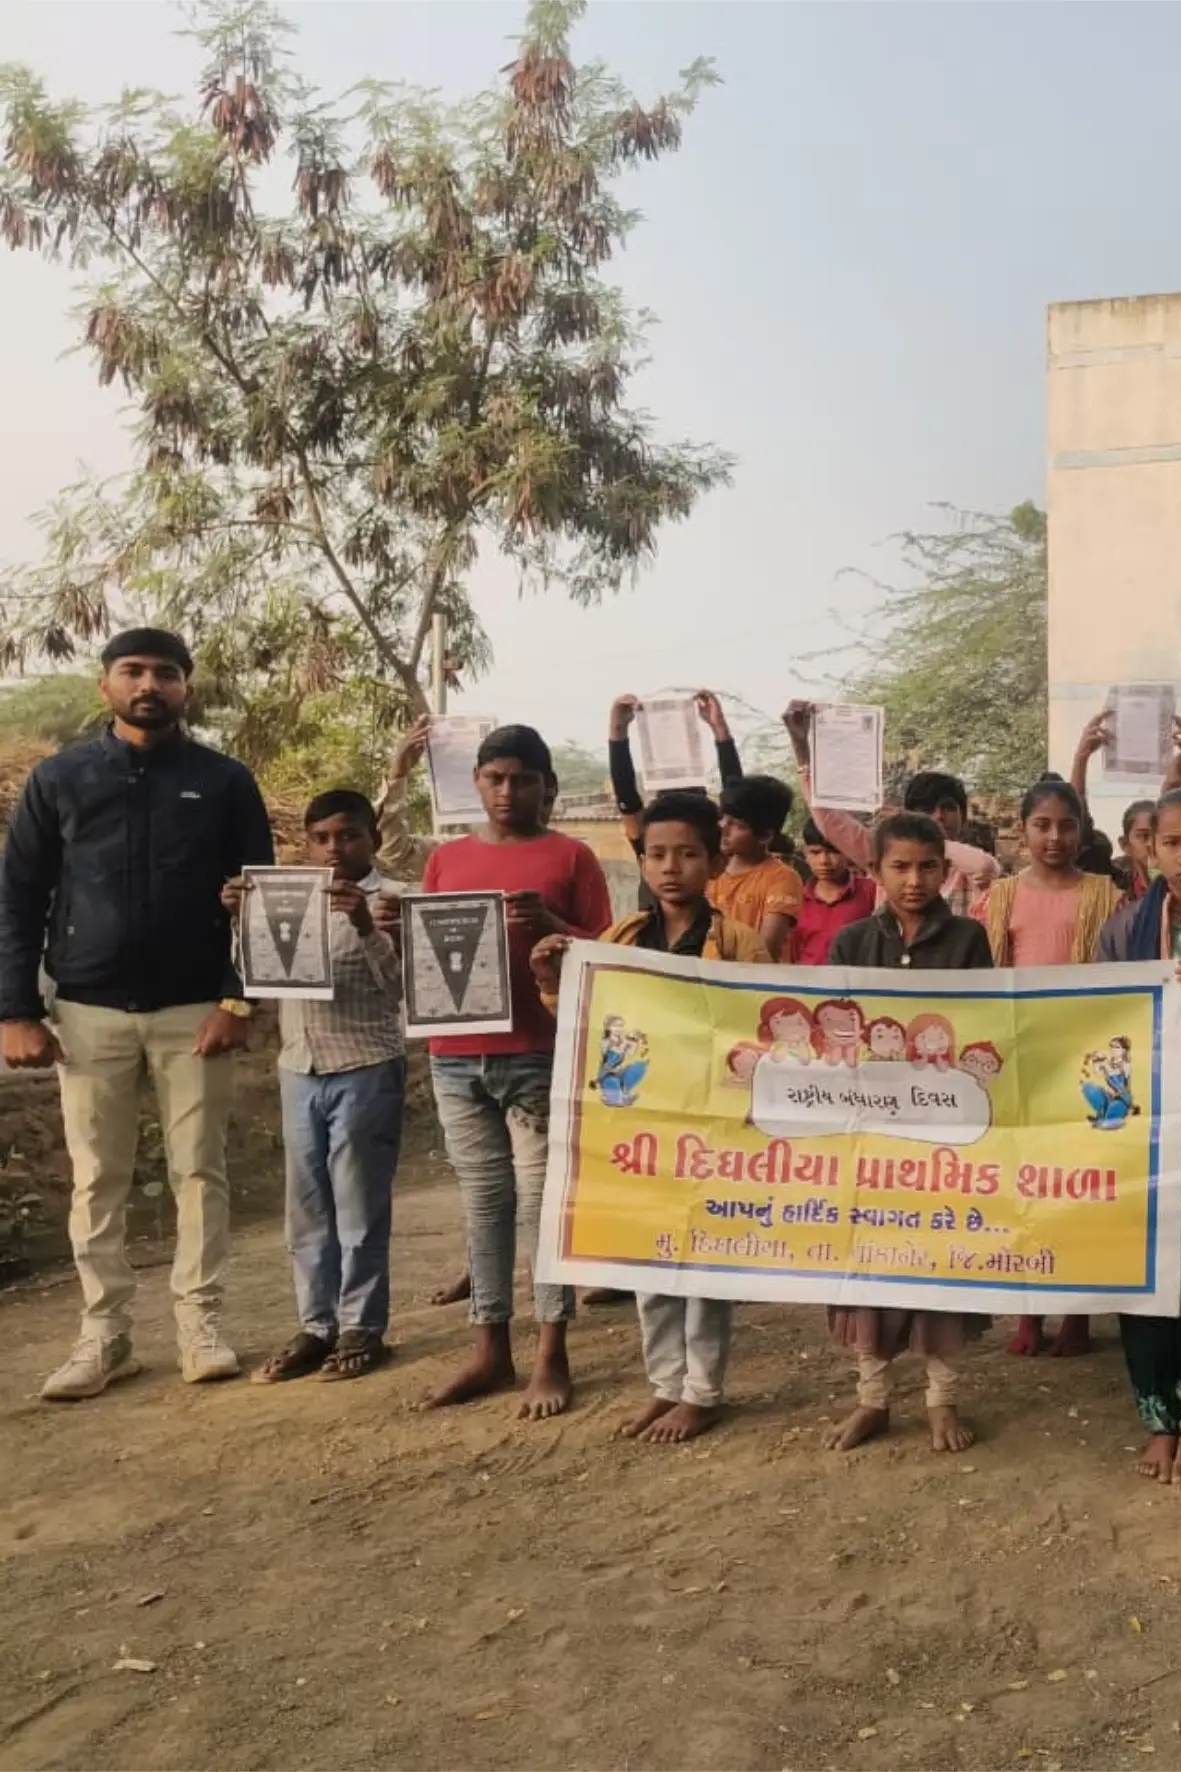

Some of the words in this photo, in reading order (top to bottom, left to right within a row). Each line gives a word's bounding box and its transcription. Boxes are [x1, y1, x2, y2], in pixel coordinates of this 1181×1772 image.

[911, 1085, 958, 1108] દિવસ
[610, 1132, 658, 1177] શ્રી
[675, 1134, 839, 1186] દિઘલીયા
[856, 1147, 1000, 1195] પ્રાથમિક
[1017, 1164, 1117, 1201] શાળા
[705, 1196, 774, 1227] આપનું
[782, 1199, 839, 1225] હાર્દિક
[849, 1207, 920, 1229] સ્વાગત
[930, 1205, 957, 1230] કરે
